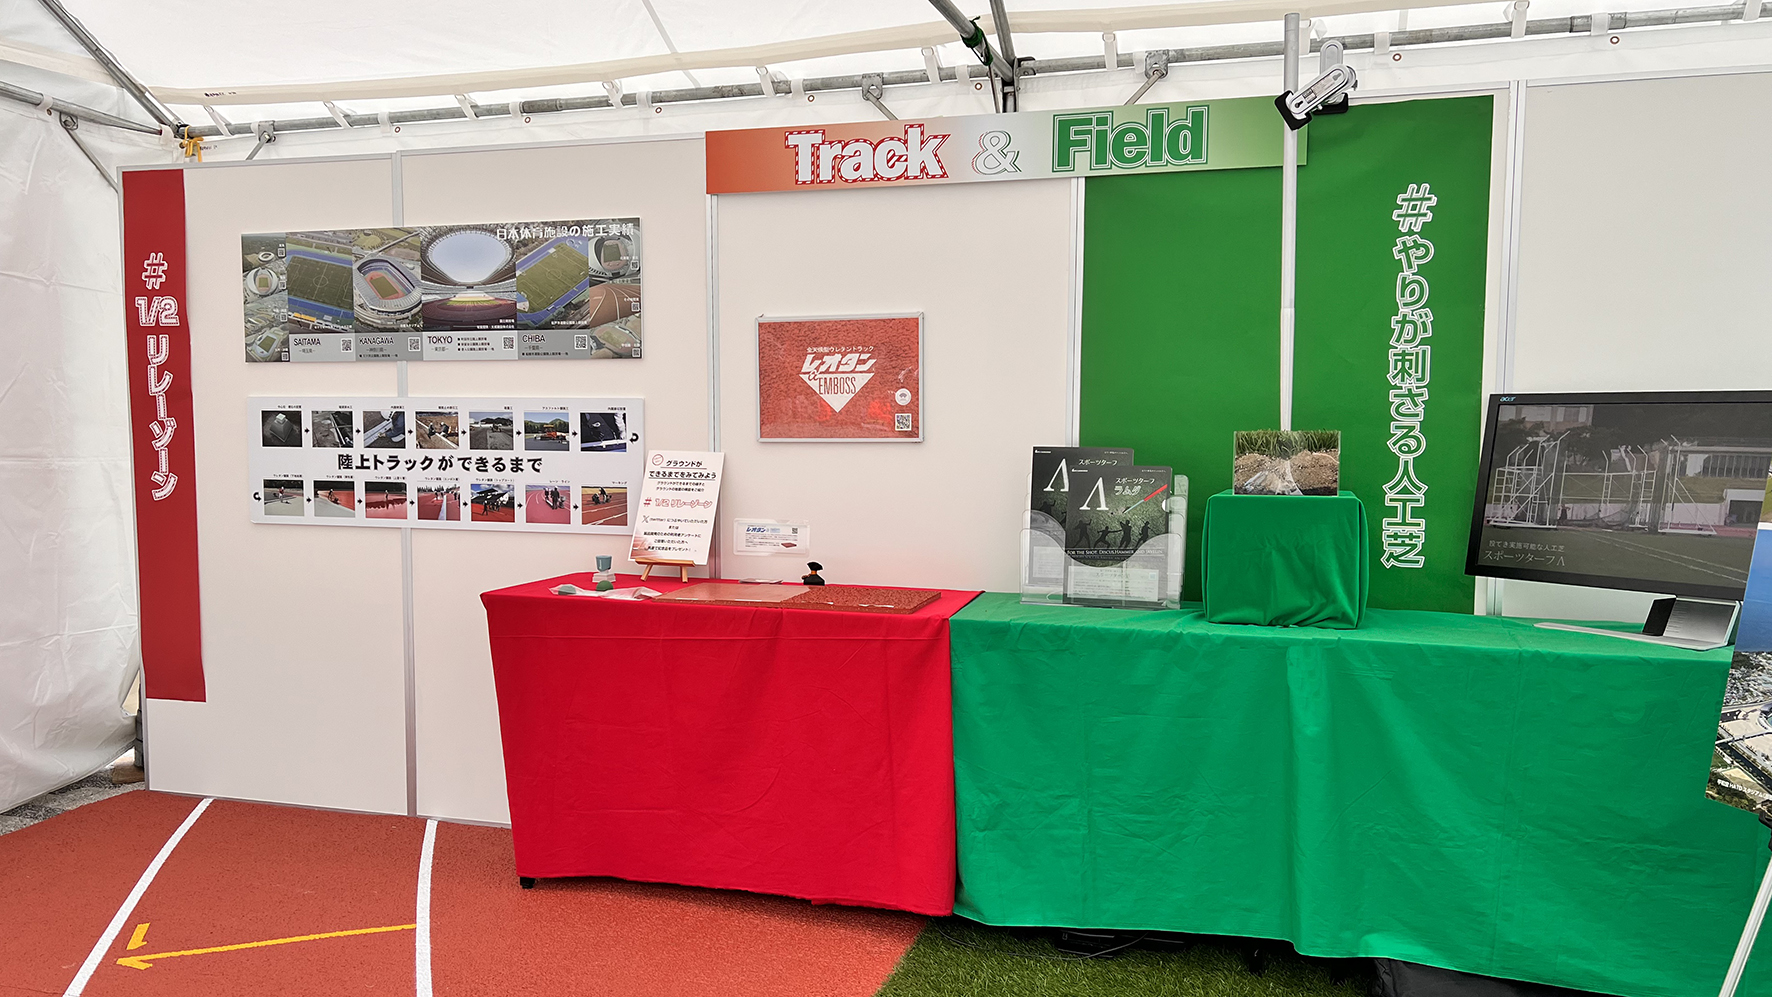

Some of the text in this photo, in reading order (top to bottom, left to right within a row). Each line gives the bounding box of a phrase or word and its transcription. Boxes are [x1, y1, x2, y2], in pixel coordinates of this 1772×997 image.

[785, 105, 1209, 186] Track & Field
[496, 222, 635, 241] 日本体育施設の施工実績
[293, 338, 321, 346] SAITAMA
[358, 336, 394, 345] KANAGAWA
[427, 335, 453, 344] TOKYO
[522, 334, 546, 342] CHIBA
[801, 354, 877, 373] レオタン
[1380, 183, 1438, 569] #やりが刺さる人工芝
[819, 377, 857, 395] EMBOSS
[337, 453, 544, 474] 陸上トラックができるまで
[666, 459, 703, 468] グラウンドが
[649, 471, 717, 479] できるまでをみてみよう
[1115, 477, 1155, 485] スポーツターフ
[1488, 540, 1565, 553] 投てき実施可能な人工芝
